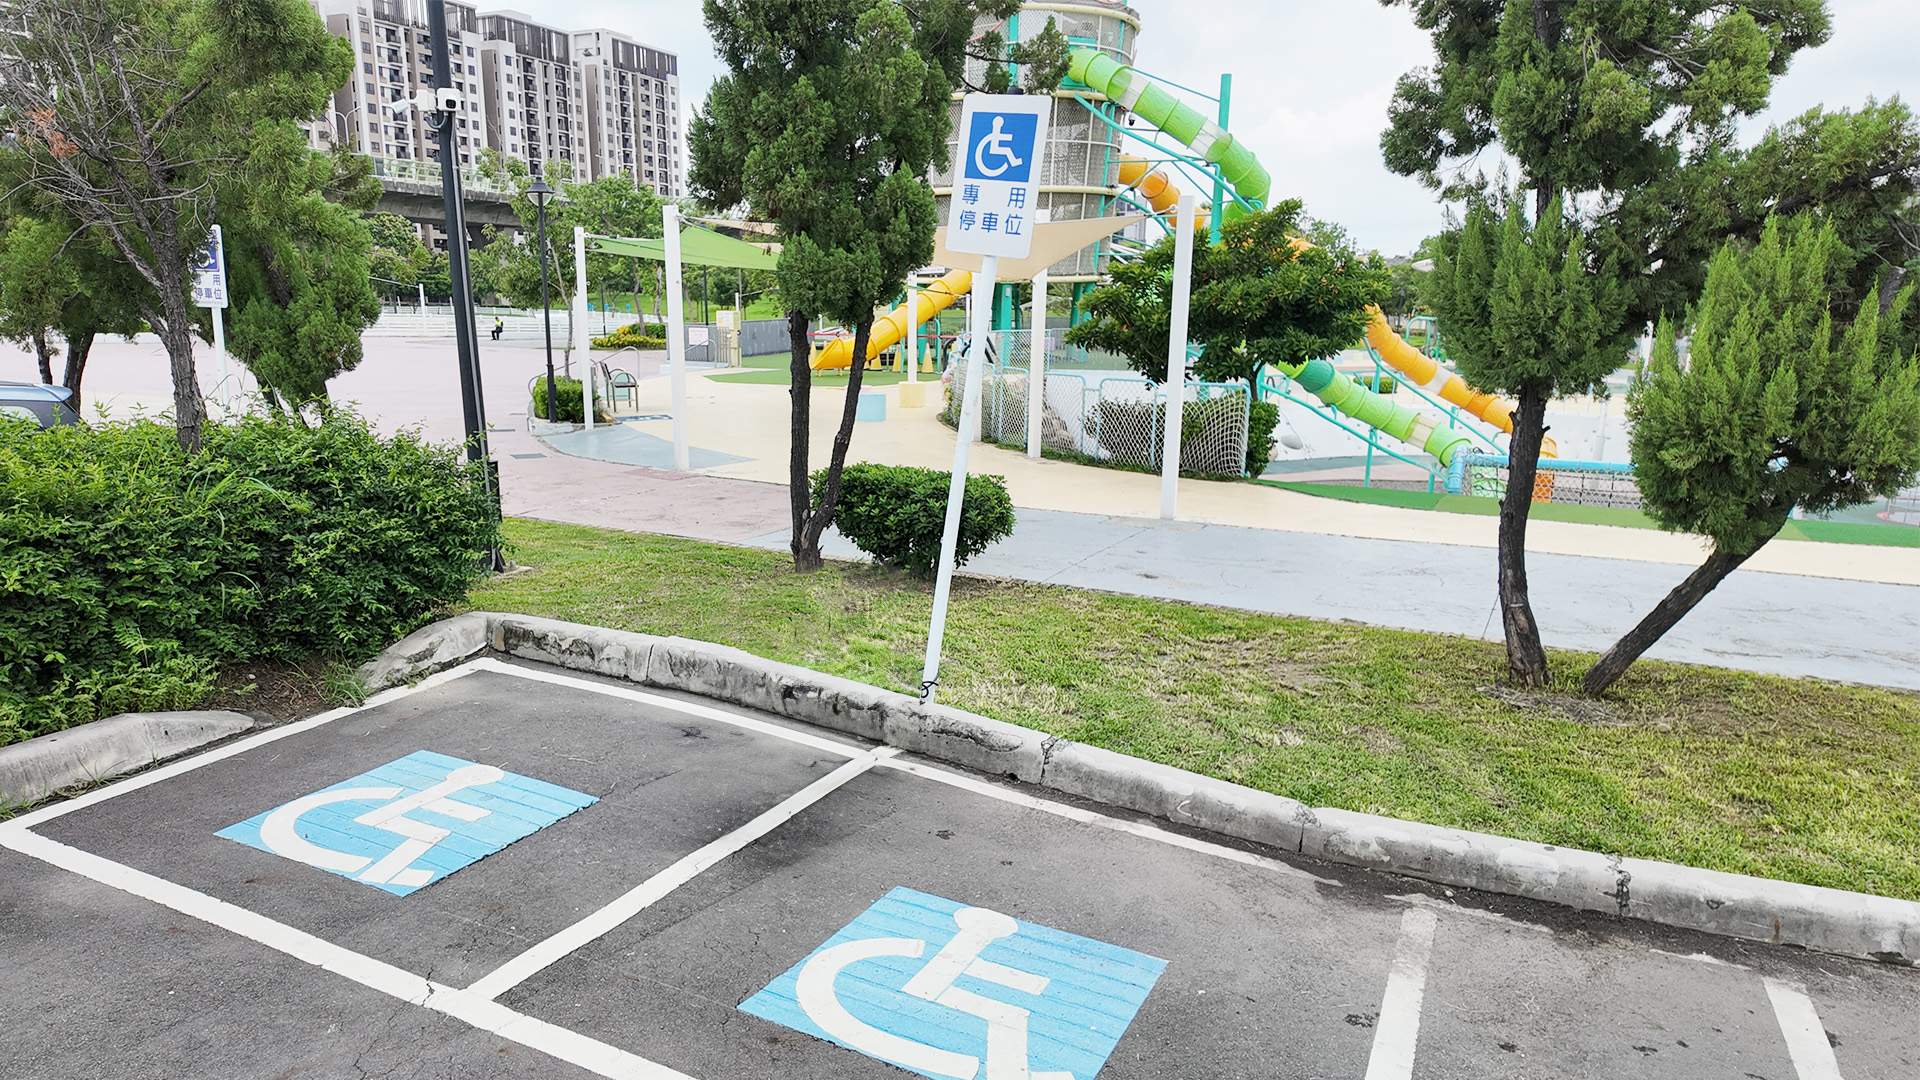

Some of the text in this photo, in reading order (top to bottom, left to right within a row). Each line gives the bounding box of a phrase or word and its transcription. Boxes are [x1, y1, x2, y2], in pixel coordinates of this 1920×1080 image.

[962, 184, 1026, 209] 專用
[959, 210, 1023, 235] 停車位
